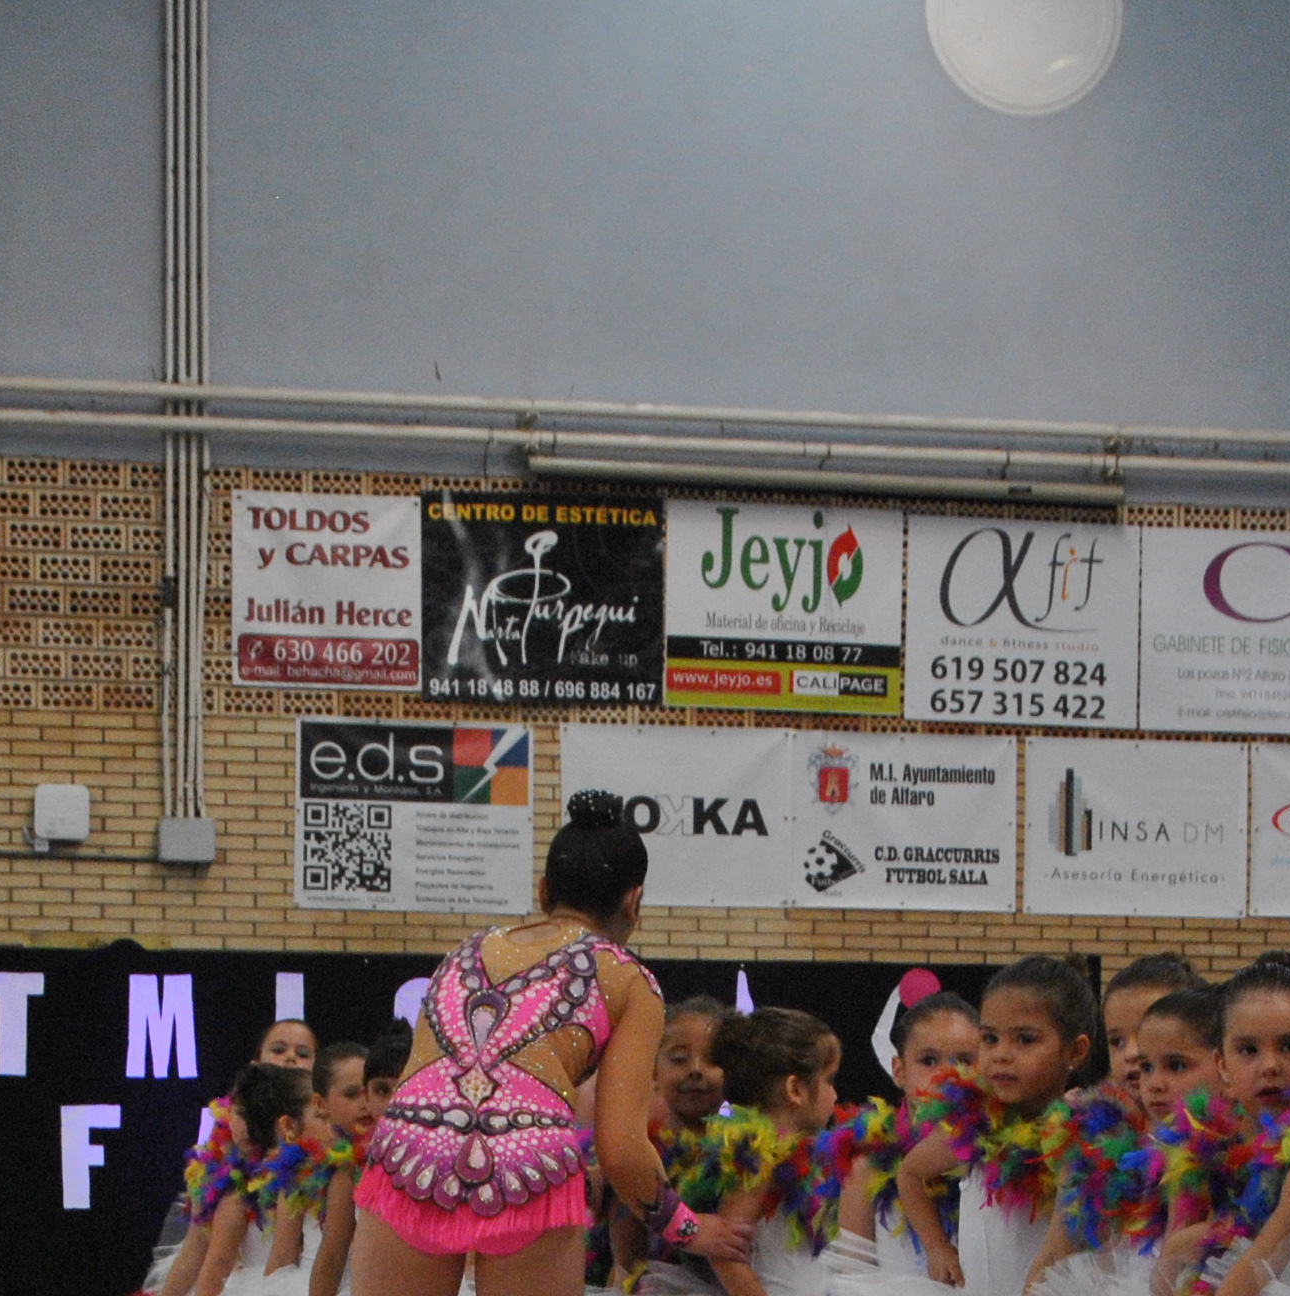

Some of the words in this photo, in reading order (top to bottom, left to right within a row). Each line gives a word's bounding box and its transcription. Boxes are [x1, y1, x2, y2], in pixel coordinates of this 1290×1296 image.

[246, 506, 371, 533] TOLDOS
[427, 503, 515, 522] CENTRO
[522, 505, 549, 523] DE
[257, 546, 275, 569] y
[285, 542, 410, 569] CARPAS
[701, 506, 865, 614] Jeyjo
[245, 597, 325, 625] Julián
[335, 600, 412, 627] Herce
[706, 612, 752, 630] Material
[755, 615, 769, 630] de
[770, 615, 807, 633] oficina
[808, 620, 817, 635] y
[818, 616, 866, 638] Reciclaje
[274, 639, 315, 662] 630
[322, 641, 363, 664] 466
[371, 643, 410, 666] 202
[699, 639, 738, 659] Tel.:
[745, 642, 777, 660] 941
[786, 643, 807, 661] 18
[813, 644, 835, 662] 08
[841, 647, 863, 663] 77
[940, 634, 983, 648] dance
[1002, 636, 1049, 650] fitness
[1055, 640, 1100, 652] studio
[1152, 634, 1225, 656] GABINETE
[1230, 636, 1252, 656] DE
[672, 671, 774, 688] www.jeyjo.es
[930, 655, 985, 681] 619
[992, 658, 1046, 684] 507
[1053, 660, 1108, 687] 824
[429, 678, 460, 696] 941
[467, 679, 488, 697] 18
[493, 679, 514, 698] 48
[519, 680, 540, 699] 88
[555, 681, 585, 700] 696
[590, 682, 621, 701] 884
[626, 683, 657, 702] 167
[929, 688, 984, 715] 657
[992, 692, 1045, 717] 315
[1052, 694, 1107, 720] 422
[310, 732, 445, 783] e.d.s
[869, 762, 898, 783] M.I.
[902, 763, 996, 786] Ayuntamiento
[869, 786, 887, 805] de
[891, 786, 936, 807] Alfaro
[1098, 820, 1171, 844] INSA
[1182, 821, 1225, 845] DM
[874, 846, 901, 862] C.D.
[904, 846, 1001, 865] GRACCURRIS
[885, 867, 947, 885] FUTBOL
[949, 869, 989, 886] SALA
